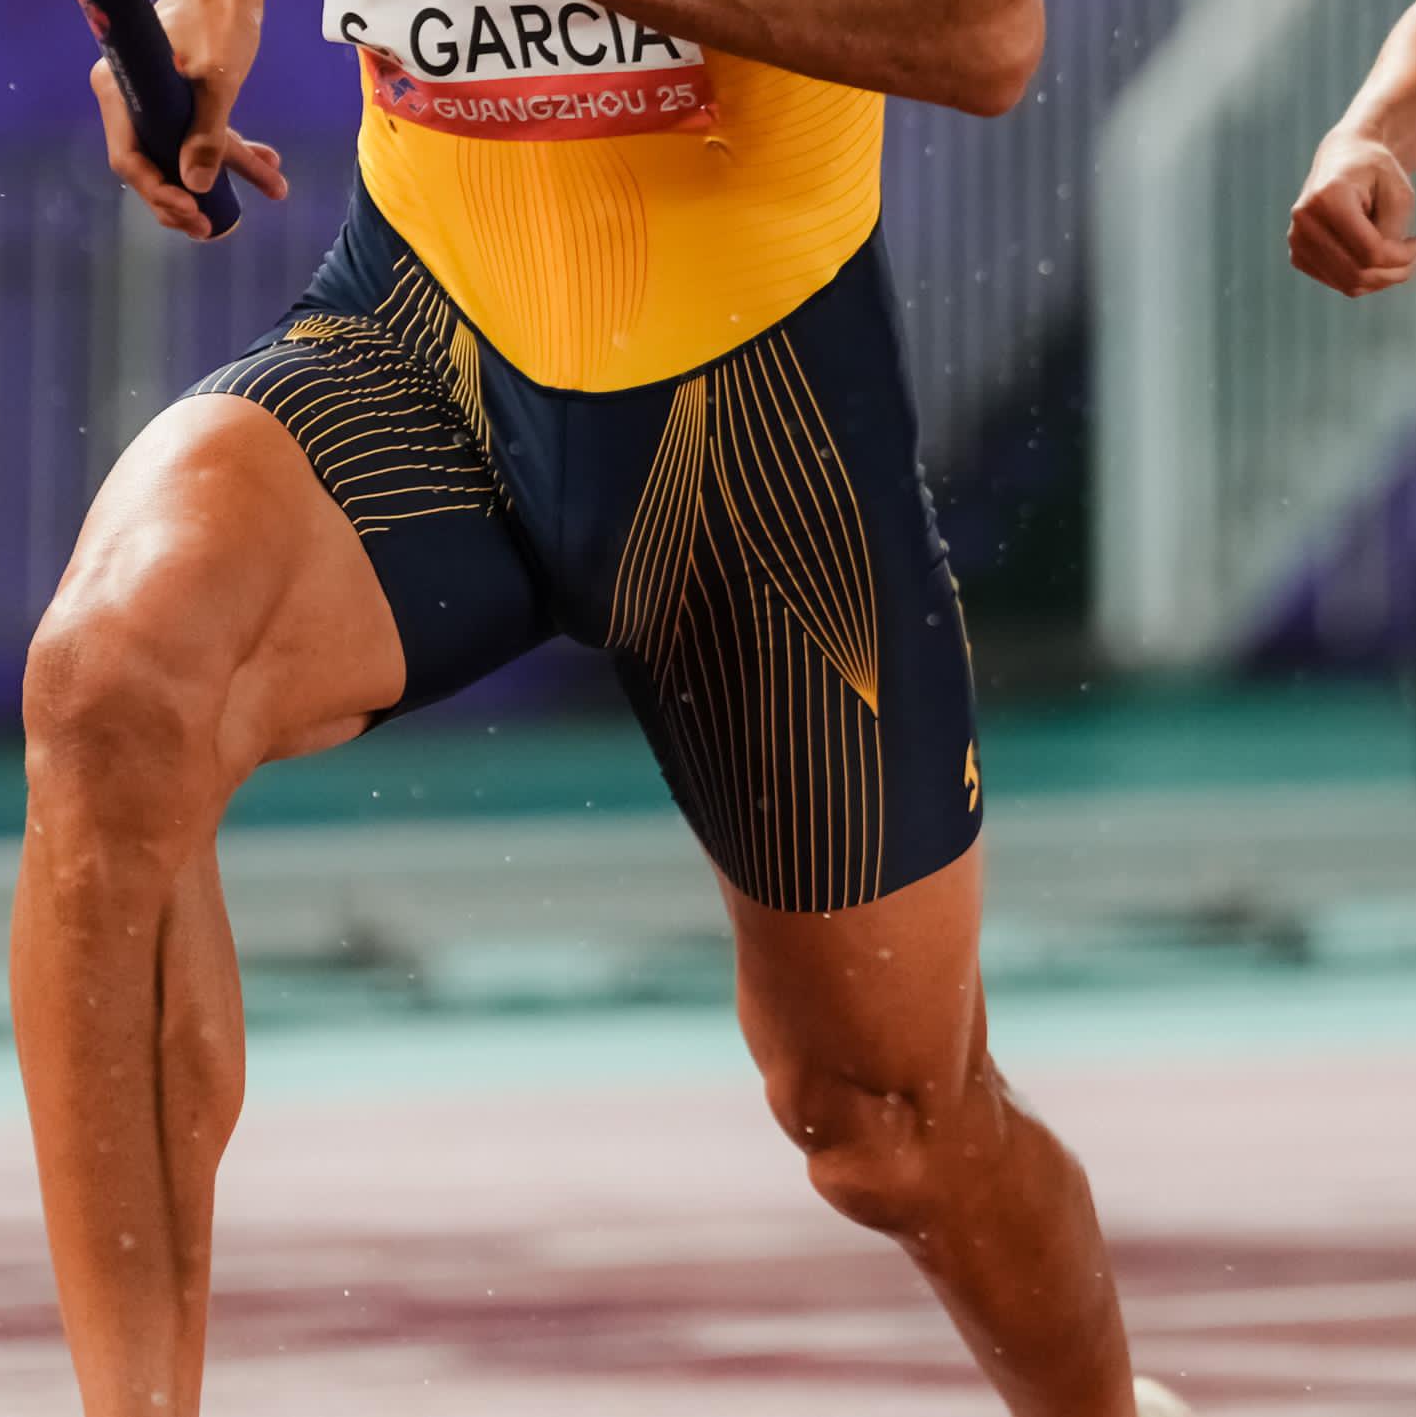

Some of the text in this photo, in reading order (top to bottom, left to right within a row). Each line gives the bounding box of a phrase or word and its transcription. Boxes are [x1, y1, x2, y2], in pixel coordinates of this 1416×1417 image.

[410, 2, 682, 77] GARCIA
[433, 83, 697, 123] GUANGZHOU 25
